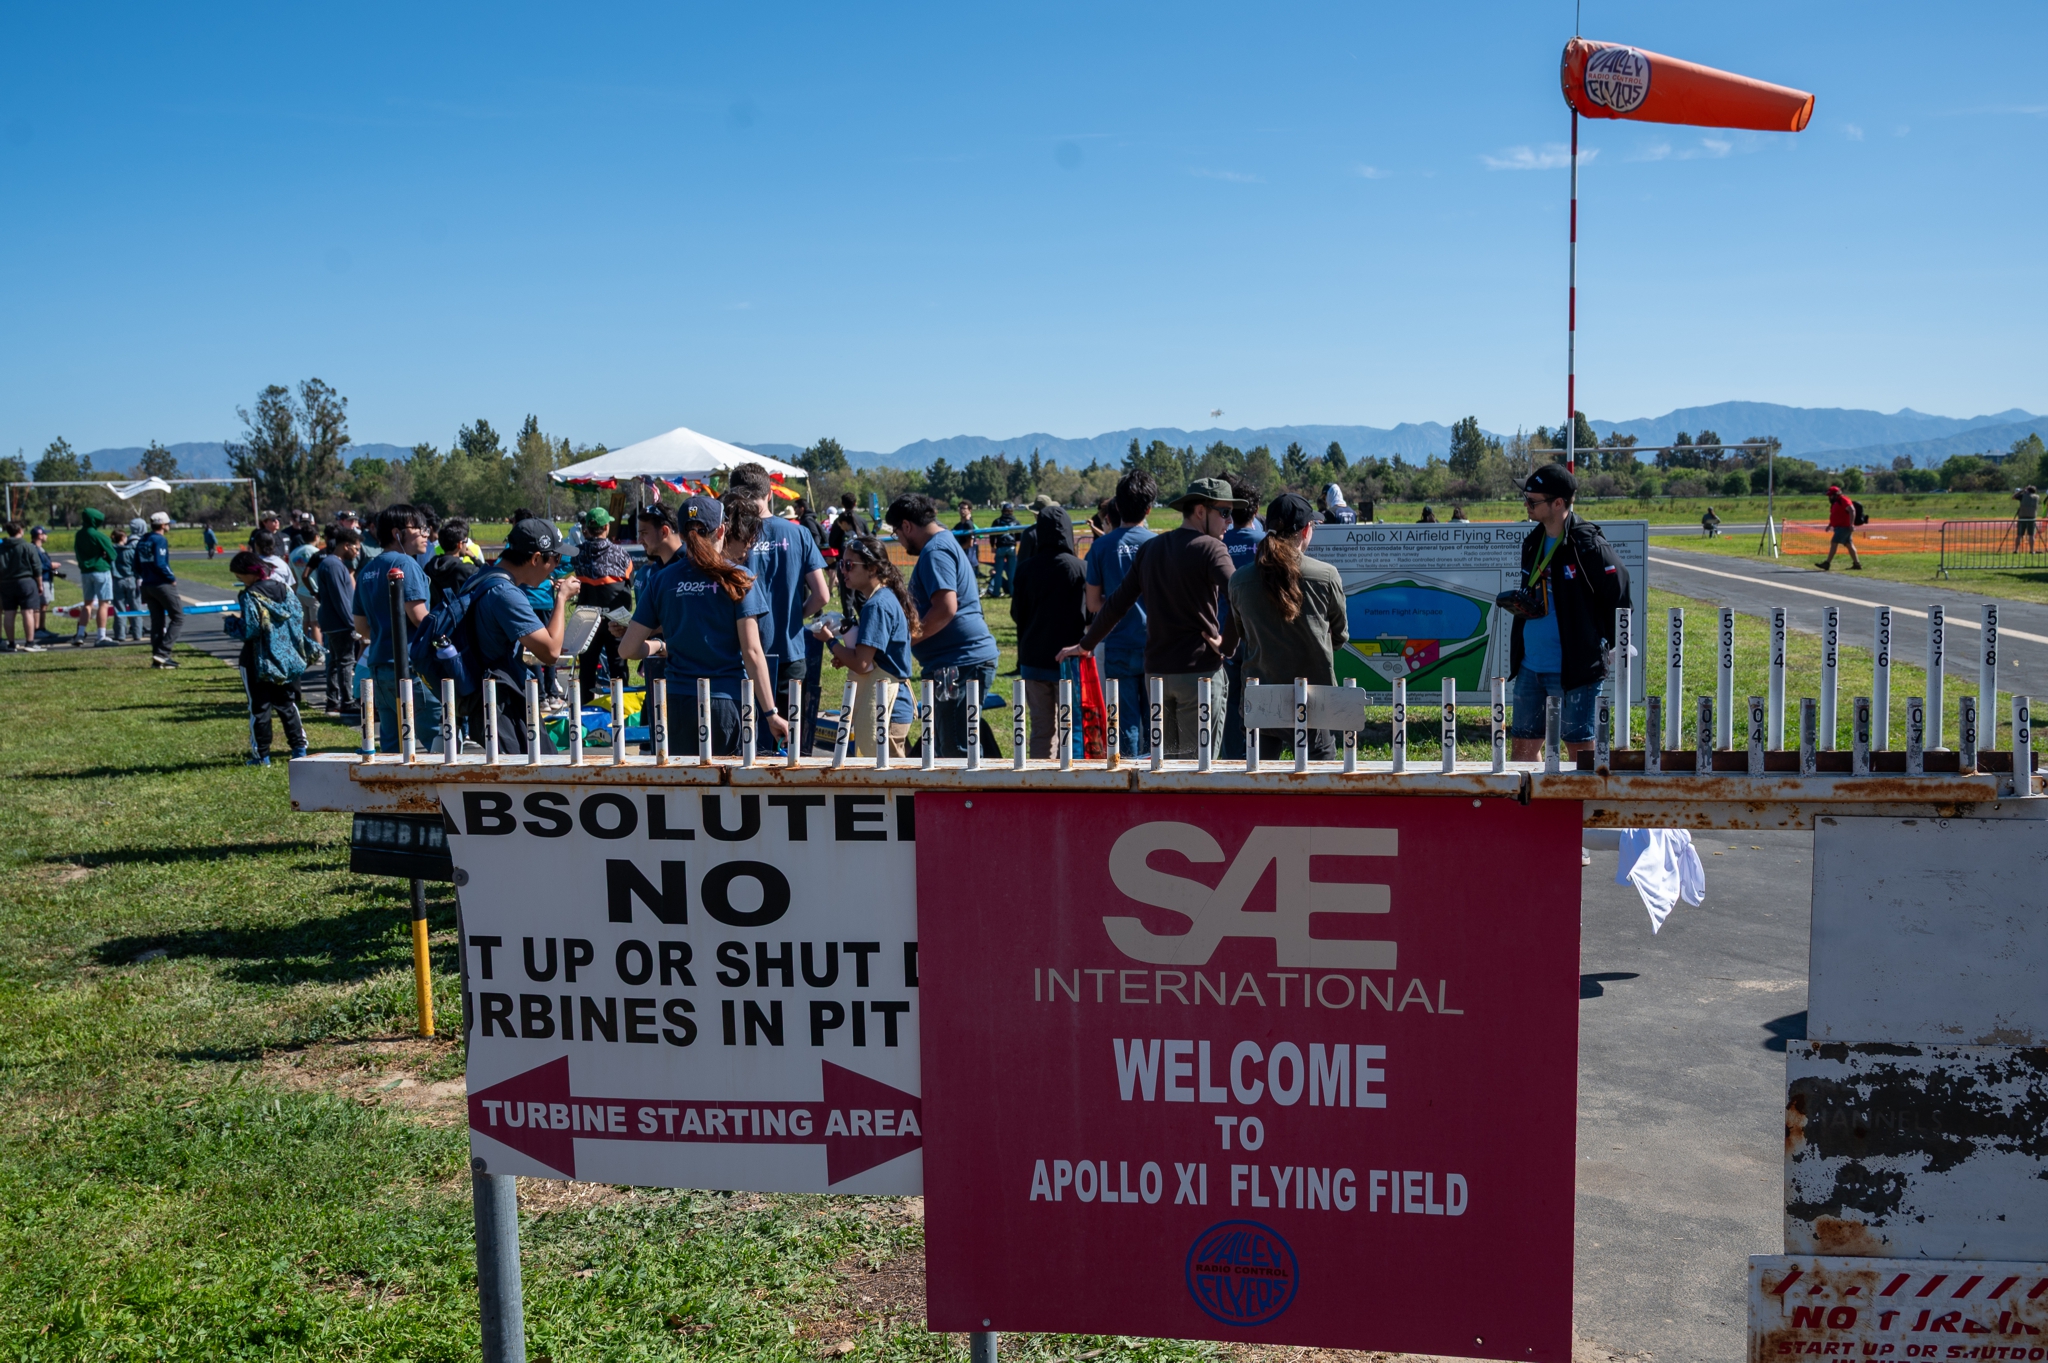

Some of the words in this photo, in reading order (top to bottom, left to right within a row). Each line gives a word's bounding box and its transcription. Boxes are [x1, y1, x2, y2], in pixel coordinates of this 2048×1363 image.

[1612, 74, 1643, 85] CONTROL
[1228, 544, 1248, 554] 2025
[1346, 531, 1386, 545] Apollo
[1390, 531, 1402, 541] XI
[1406, 530, 1449, 541] Airfield
[1454, 529, 1491, 543] Flying
[676, 581, 706, 593] 2025
[1392, 608, 1411, 617] Flight
[1412, 608, 1443, 617] Airspace
[1619, 613, 1629, 668] 53.1
[1672, 615, 1683, 668] 53.2
[1723, 613, 1733, 669] 53.3
[1827, 612, 1838, 668] 53.5
[1878, 611, 1890, 667] 53.6
[1932, 611, 1943, 667] 53.7
[1986, 610, 1997, 666] 53.8
[401, 703, 411, 740] 12
[442, 703, 453, 741] 13
[484, 703, 494, 741] 14
[569, 703, 579, 742] 16
[611, 703, 623, 742] 17
[654, 704, 666, 743] 18
[698, 704, 709, 743] 19
[742, 704, 753, 744] 20
[788, 704, 799, 744] 21
[836, 704, 851, 745] 22
[876, 704, 887, 745] 23
[921, 704, 932, 745] 24
[967, 704, 978, 745] 25
[1013, 704, 1025, 746] 26
[1060, 704, 1071, 747] 27
[1151, 703, 1162, 747] 29
[1199, 703, 1210, 747] 30
[1295, 703, 1307, 748] 32
[1394, 703, 1405, 748] 34
[1443, 703, 1454, 748] 35
[1493, 703, 1504, 748] 36
[1701, 708, 1712, 744] 03
[1752, 708, 1763, 744] 04
[1912, 708, 1923, 744] 07
[1966, 708, 1976, 744] 08
[2018, 707, 2029, 744] 09
[353, 819, 449, 848] TURBIN
[442, 791, 916, 842] BSOLUTE
[605, 858, 791, 928] NO
[1102, 820, 1399, 971] SAE
[522, 936, 595, 983] UP
[615, 939, 697, 987] OR
[715, 941, 881, 988] SHUT
[1034, 967, 1465, 1016] INTERNATIONAL
[467, 991, 698, 1047] RBINES
[721, 1000, 785, 1047] IN
[1112, 1038, 1388, 1109] WELCOME
[481, 1099, 627, 1133] TURBINE
[637, 1106, 813, 1137] STARTING
[824, 1108, 921, 1137] AREA
[1214, 1115, 1265, 1151] TO
[1029, 1159, 1163, 1204] APOLLO
[1173, 1163, 1208, 1206] XI
[1229, 1164, 1357, 1212] FLYING
[1368, 1169, 1469, 1217] FIELD
[1197, 1230, 1282, 1268] VALLEY
[1195, 1264, 1231, 1274] RADIO
[1234, 1265, 1289, 1278] CONTROL
[1196, 1274, 1289, 1318] FLYERS
[1791, 1306, 1858, 1329] NO
[1777, 1341, 1855, 1355] START
[1862, 1343, 1895, 1356] UP
[1906, 1344, 1938, 1357] OR
[1946, 1345, 2048, 1360] SHUTDO
